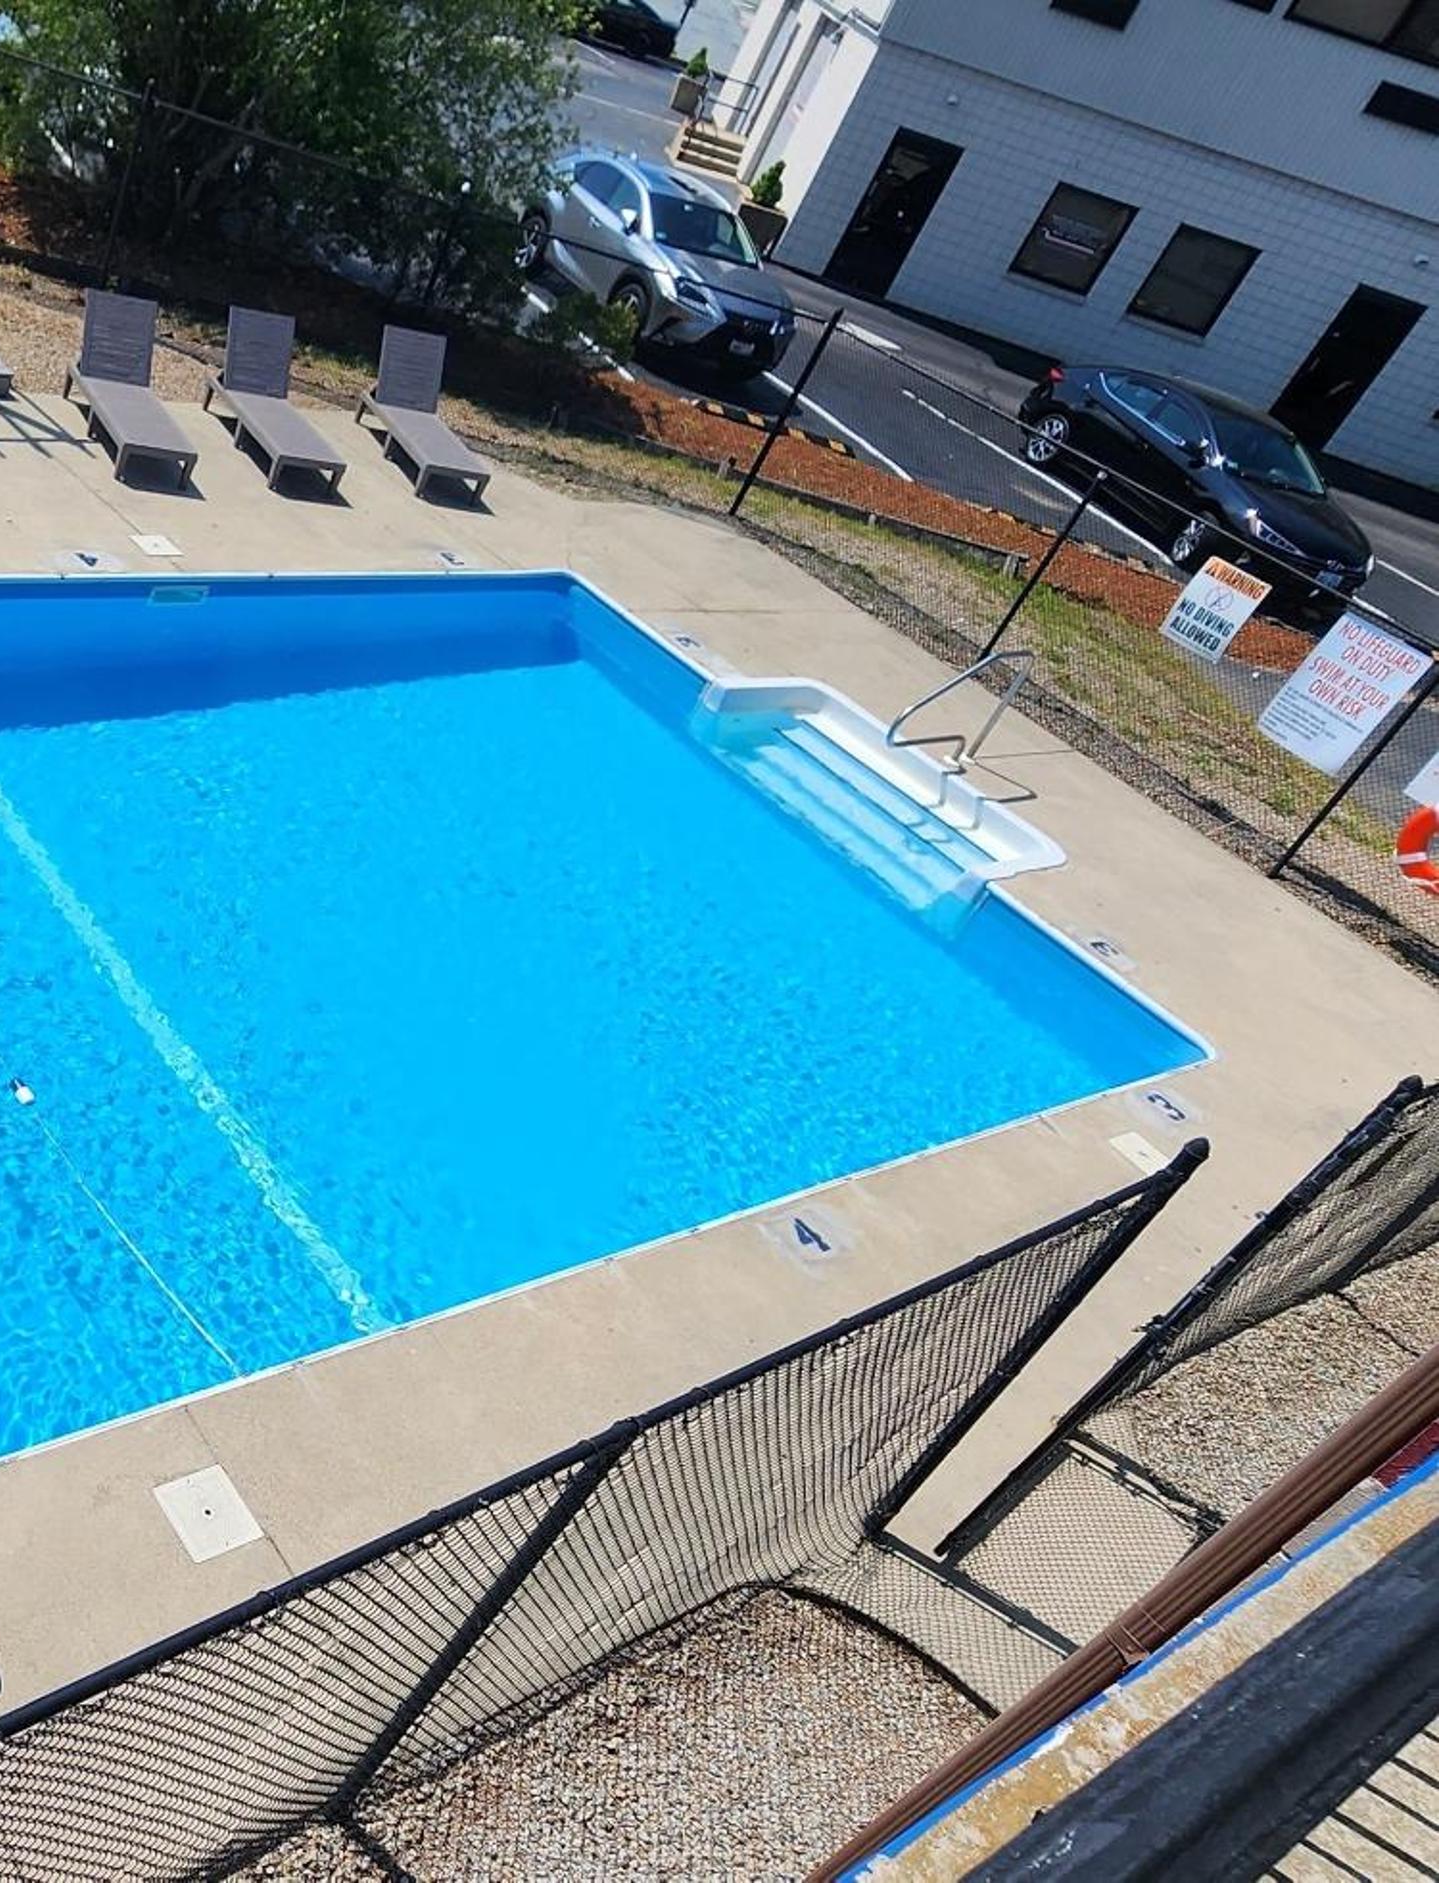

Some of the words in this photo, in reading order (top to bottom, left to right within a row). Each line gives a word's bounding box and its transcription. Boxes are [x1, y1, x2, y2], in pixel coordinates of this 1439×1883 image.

[1215, 565, 1265, 600] WARNING
[1169, 615, 1221, 652] ALLOWED
[1177, 598, 1197, 616] NO
[1192, 606, 1235, 637] DIVING
[1338, 620, 1362, 641] NO
[1357, 632, 1421, 675] LIFEGUARD
[1341, 645, 1364, 665] ON
[1358, 656, 1392, 682] DUTY
[1308, 656, 1346, 684] SWIM
[1340, 675, 1361, 692] AT
[1356, 682, 1391, 709] YOUR
[1308, 678, 1341, 704] OWN
[1336, 695, 1366, 720] RISK
[1148, 1094, 1185, 1121] 3
[794, 1218, 831, 1252] 4
